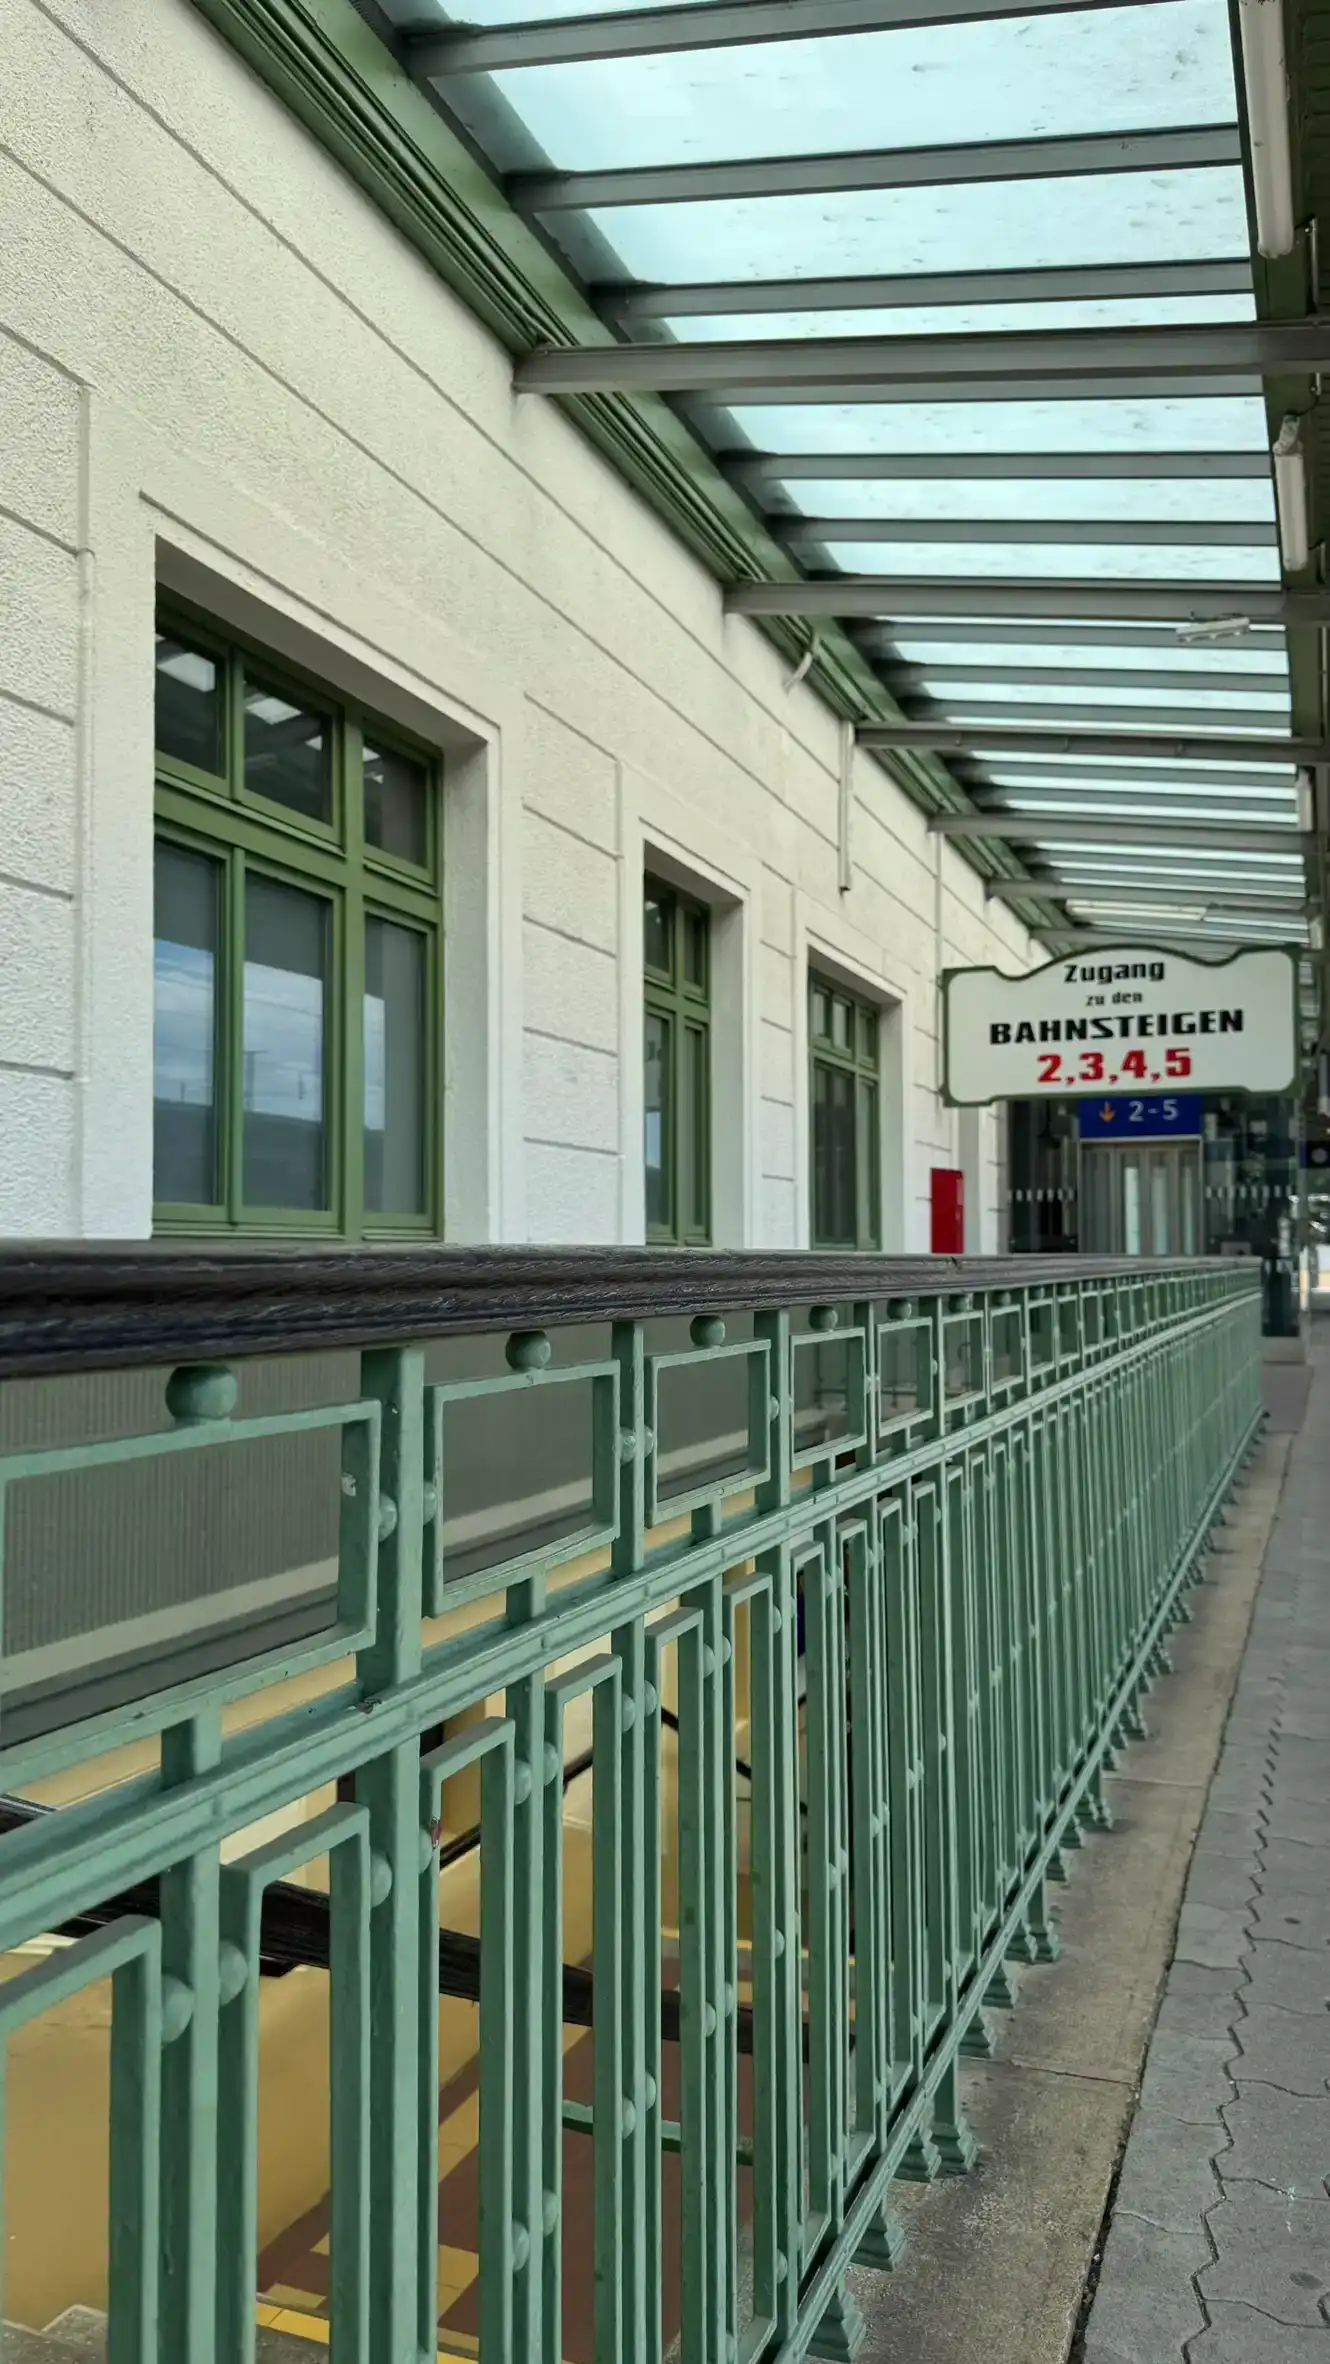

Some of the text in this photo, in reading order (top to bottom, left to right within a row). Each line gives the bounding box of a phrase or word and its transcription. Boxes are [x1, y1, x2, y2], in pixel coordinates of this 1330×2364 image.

[1064, 962, 1165, 985] Zugang
[1085, 991, 1143, 1007] zu den
[990, 1009, 1244, 1045] BAHNSTEIGEN
[1037, 1048, 1192, 1087] 2,3,4,5
